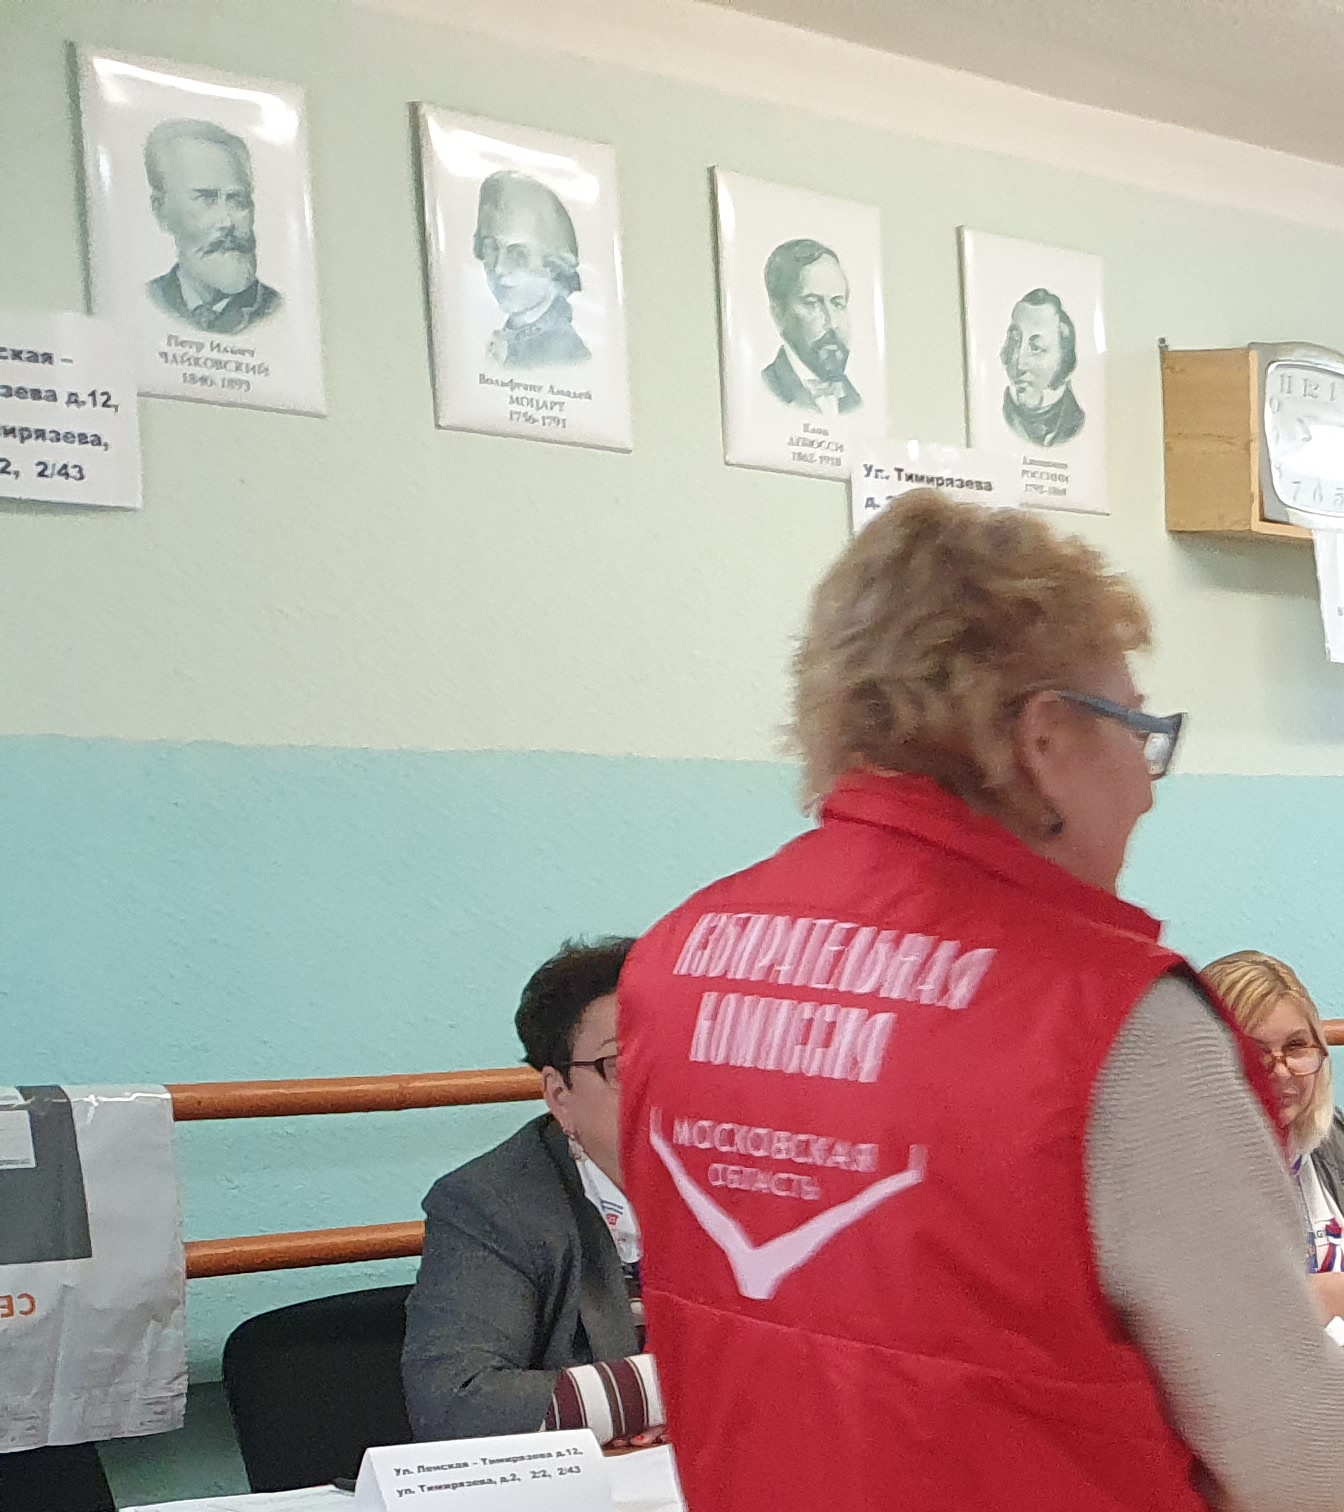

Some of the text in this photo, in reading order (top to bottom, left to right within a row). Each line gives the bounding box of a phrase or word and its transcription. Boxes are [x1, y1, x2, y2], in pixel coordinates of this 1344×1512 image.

[158, 351, 270, 376] ЧАЙКОВСКИЙ
[509, 395, 565, 412] МОЦАРТ
[509, 410, 567, 428] 1756-1791
[35, 460, 86, 481] 2/43
[863, 464, 994, 492] Ул. Тимирязева
[673, 912, 998, 1010] ИЗБИРАТЕЛЬНАЯ
[689, 991, 898, 1083] КОМИССИЯ
[673, 1116, 880, 1173] МОСКОВСКАЯ
[707, 1163, 821, 1201] ОБЛАСТЬ
